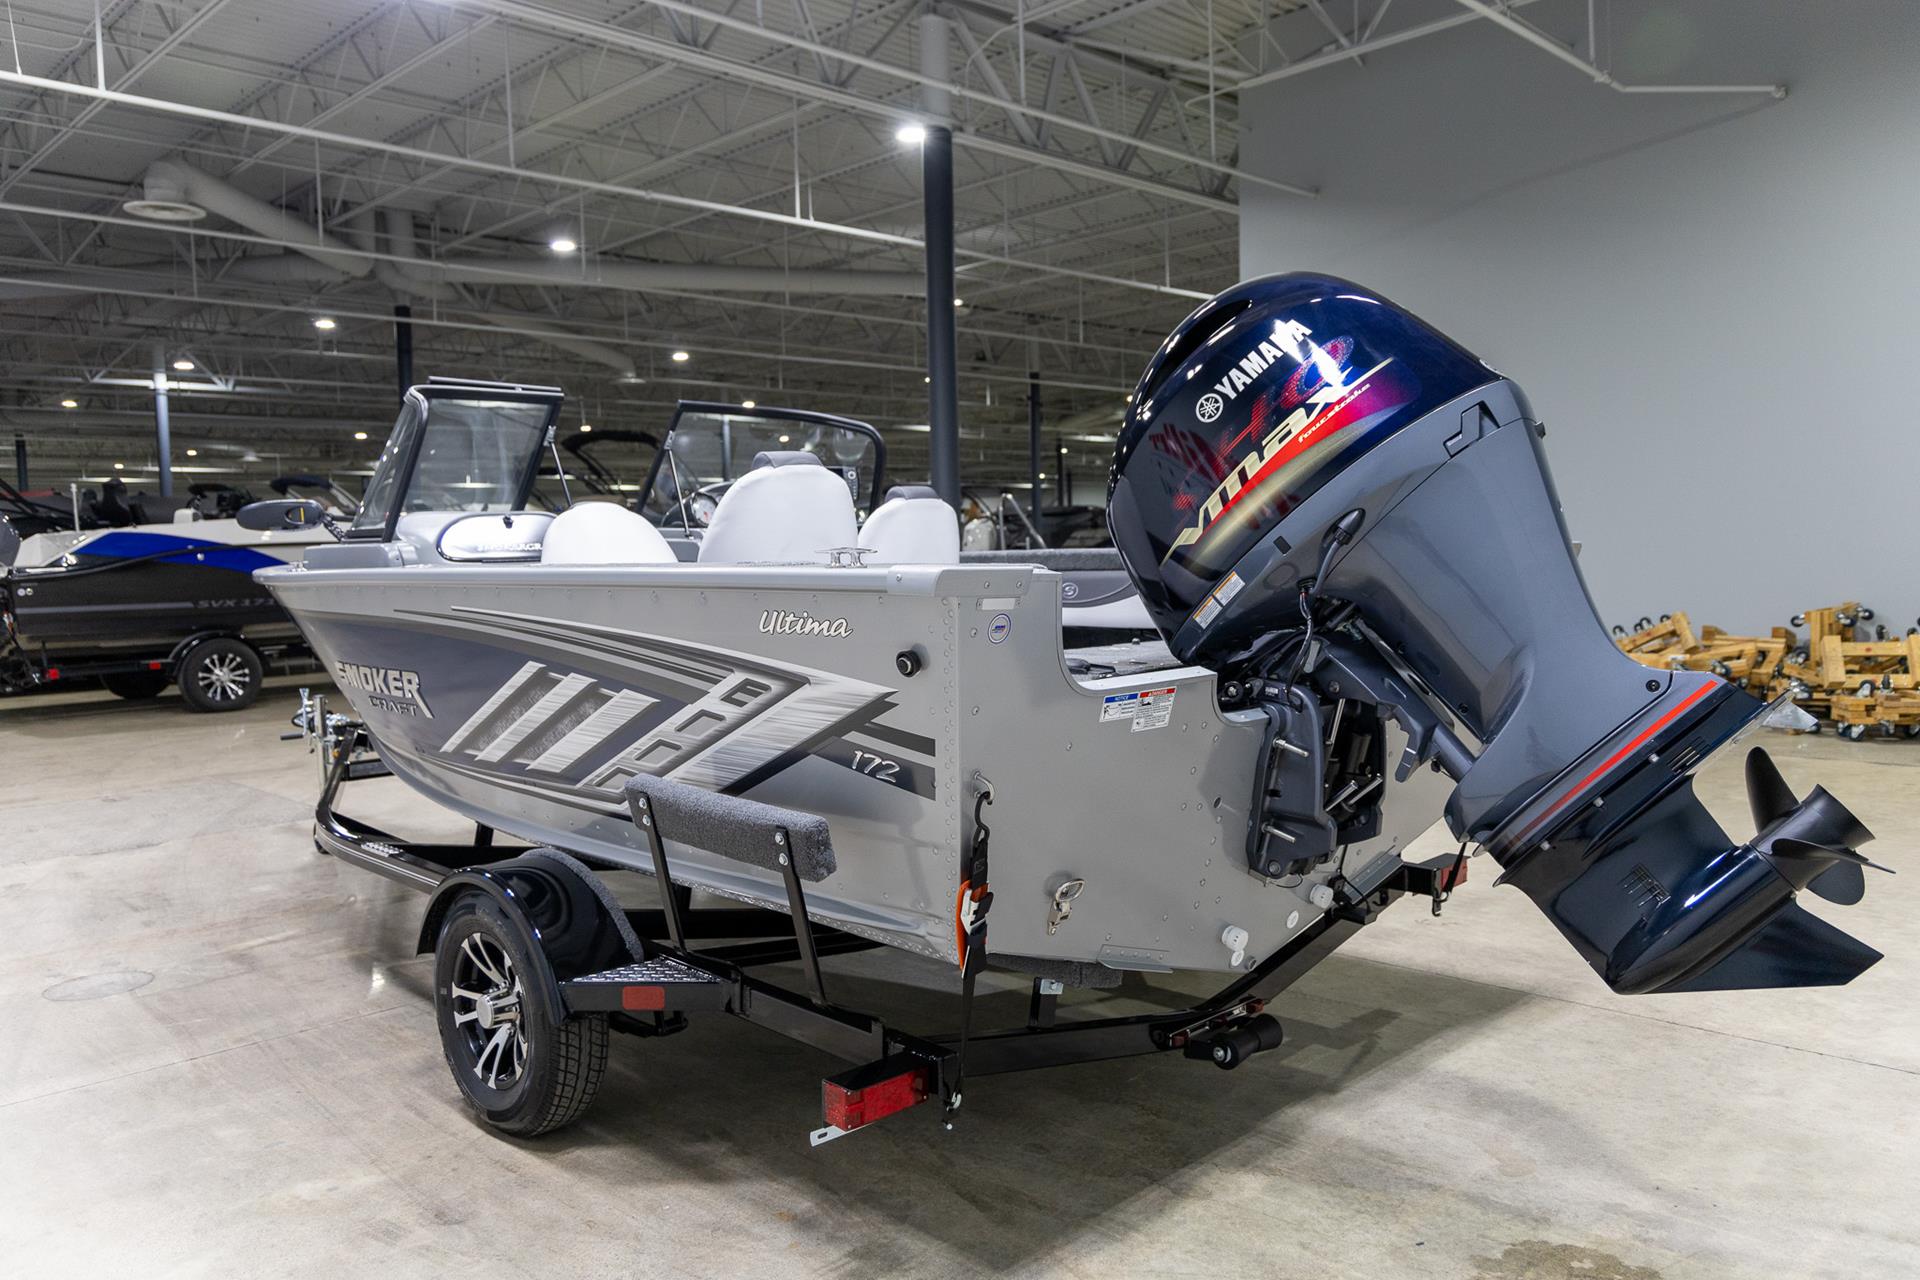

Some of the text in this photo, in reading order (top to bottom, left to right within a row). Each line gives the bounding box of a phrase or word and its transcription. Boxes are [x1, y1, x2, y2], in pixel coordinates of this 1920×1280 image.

[758, 610, 853, 639] Ultima
[368, 695, 419, 717] CRAFT
[852, 750, 901, 783] 172
